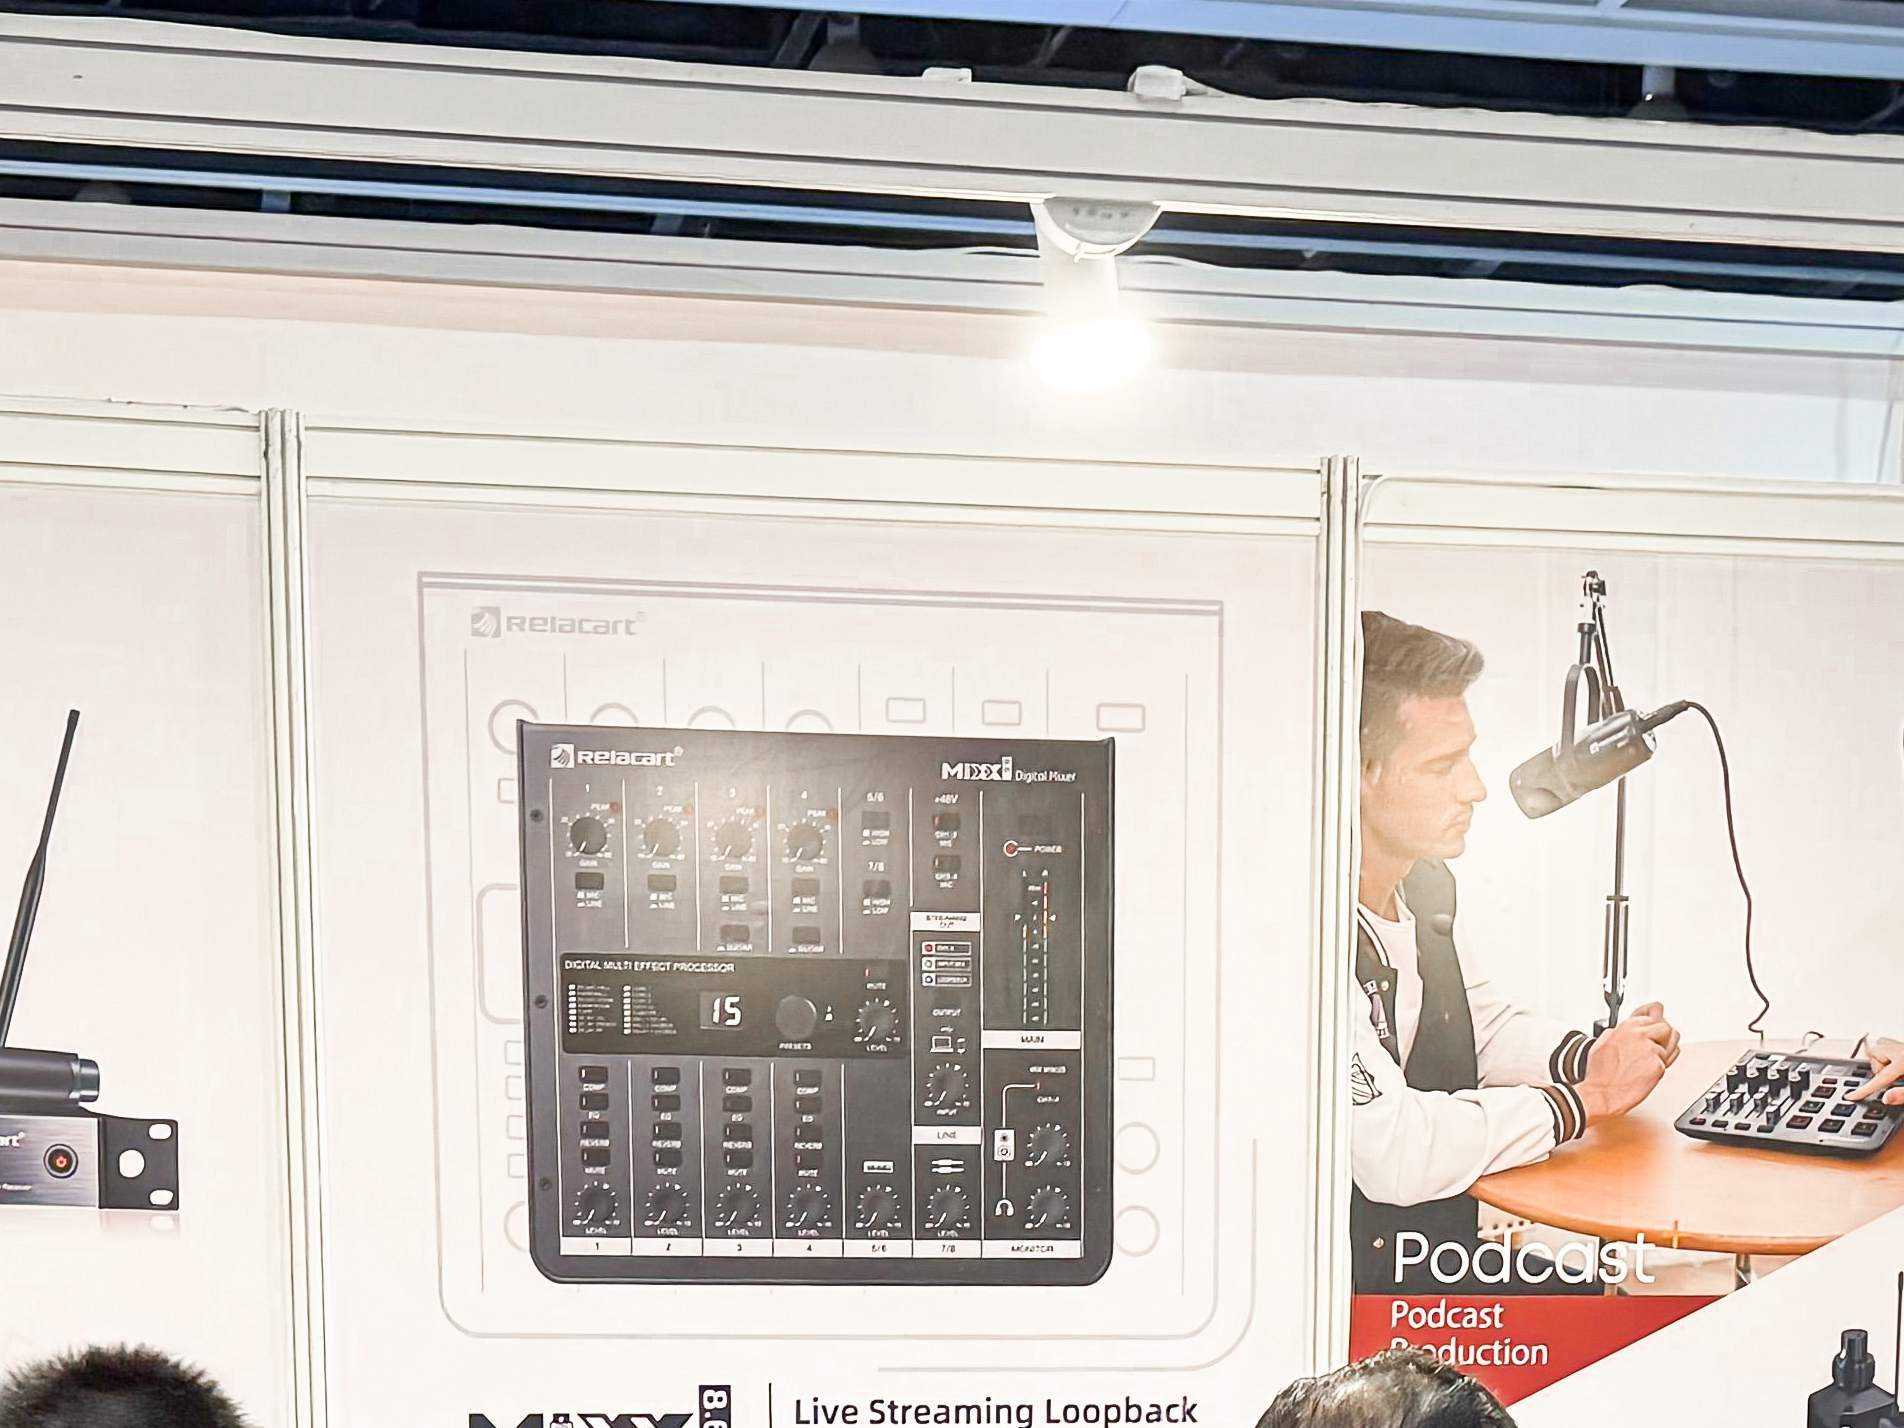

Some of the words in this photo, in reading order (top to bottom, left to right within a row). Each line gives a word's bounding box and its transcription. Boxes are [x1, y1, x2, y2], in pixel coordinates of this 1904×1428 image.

[506, 615, 638, 636] Relacart
[577, 749, 676, 767] Relacart
[564, 960, 602, 971] DIGITAL
[672, 962, 736, 973] PROCESSOR
[712, 996, 742, 1027] 15
[1394, 1231, 1656, 1284] Podcast
[1390, 1298, 1505, 1329] Podcast
[1390, 1336, 1549, 1366] Pduction
[794, 1397, 859, 1425] Live
